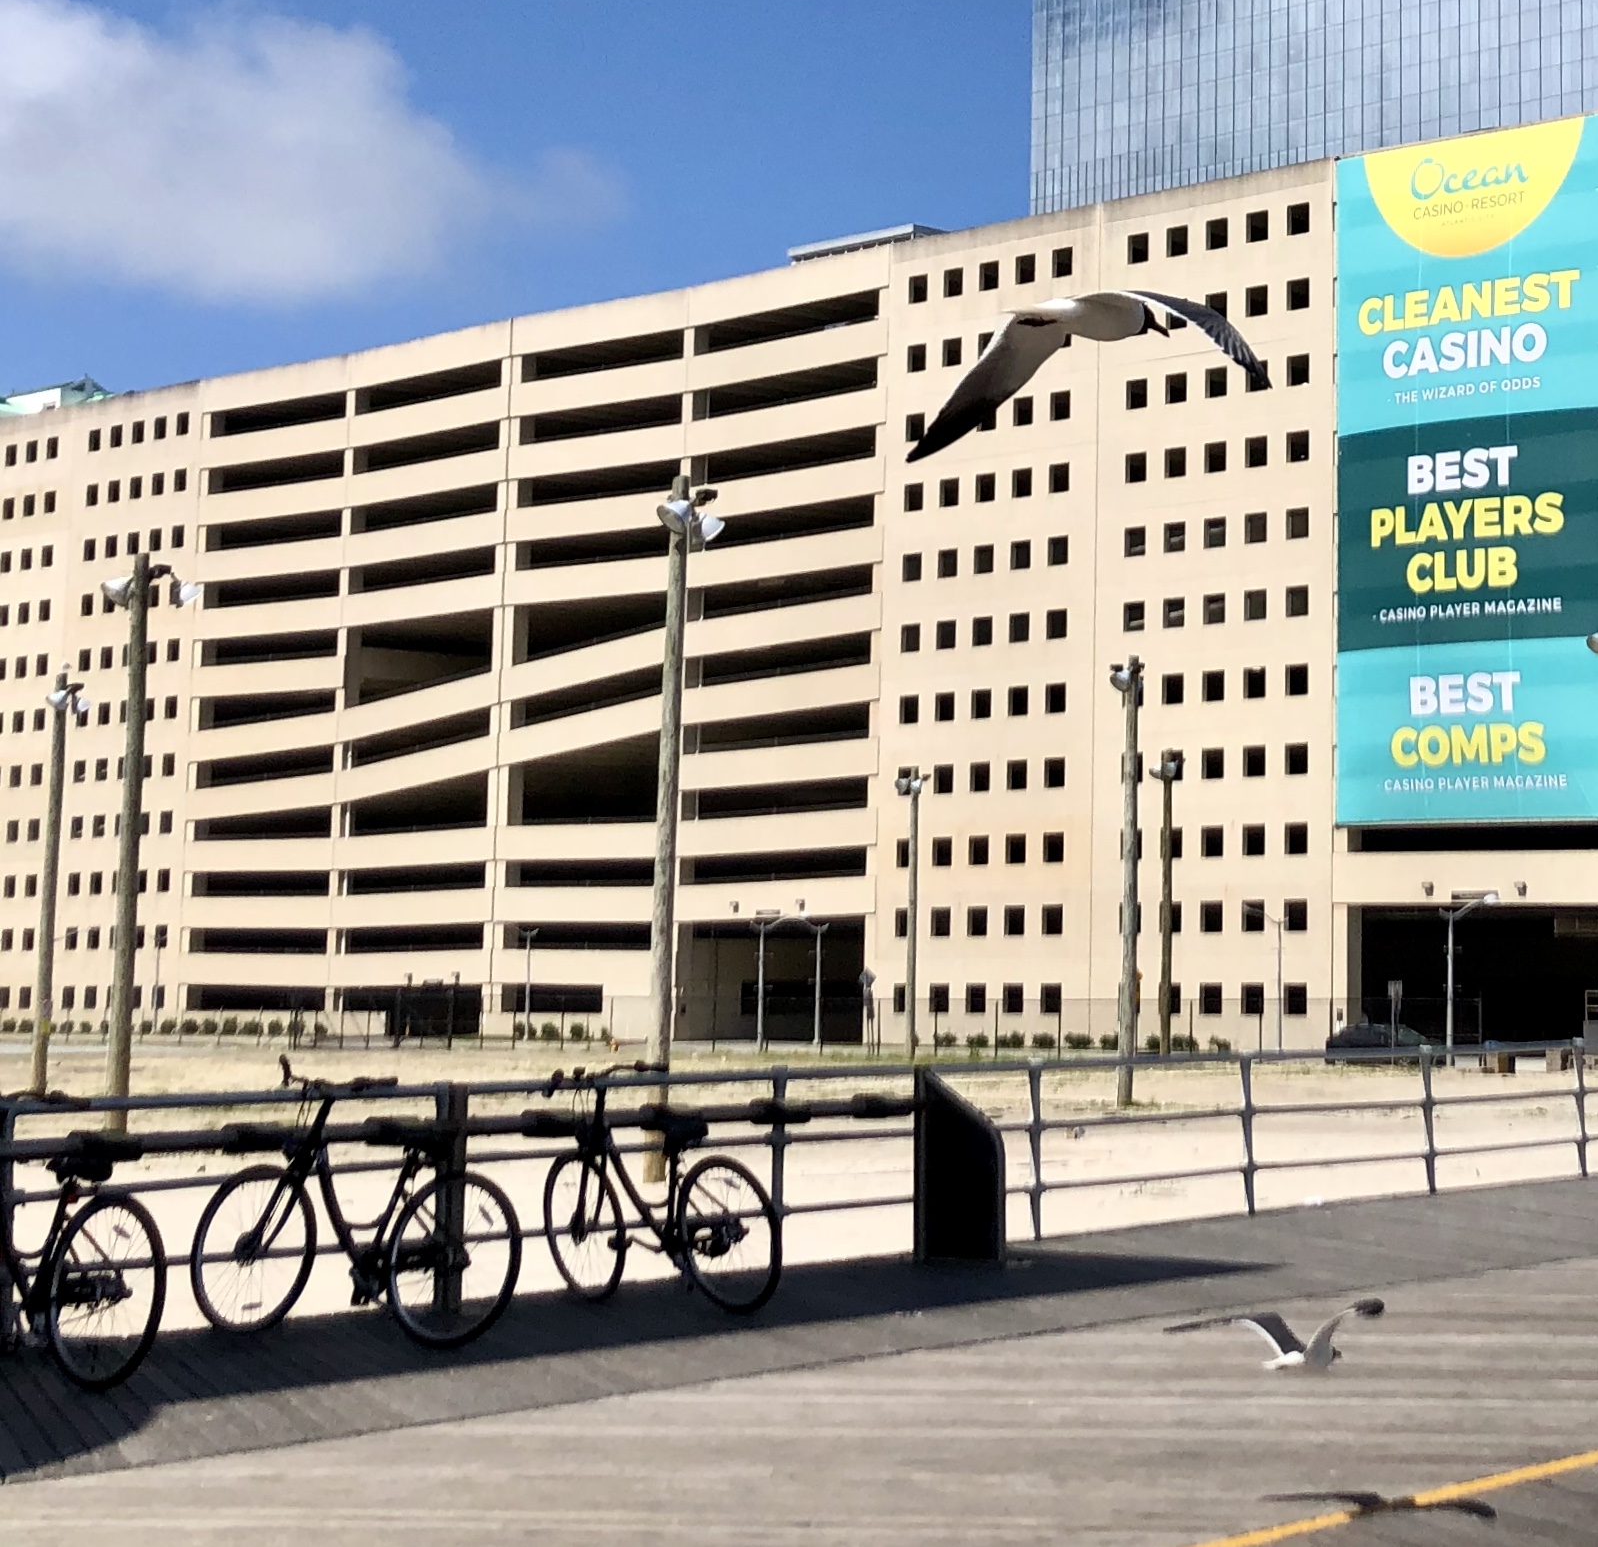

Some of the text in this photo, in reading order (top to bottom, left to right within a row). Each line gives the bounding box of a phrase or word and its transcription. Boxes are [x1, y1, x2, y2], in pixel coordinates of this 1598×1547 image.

[1410, 158, 1529, 200] Ocean
[1413, 191, 1525, 220] CASINO RESORT
[1358, 269, 1580, 336] CLEANEST
[1382, 322, 1548, 380] CASINO
[1394, 376, 1541, 404] THE WIZARD OF ODDS
[1407, 445, 1518, 495] BEST
[1370, 491, 1565, 549] PLAYERS
[1406, 545, 1518, 594] CLUB
[1379, 597, 1562, 622] CASINO PLAYER MAGAZINE
[1409, 670, 1521, 716] BEST
[1390, 721, 1546, 767] COMPS
[1384, 773, 1568, 792] CASINO PLAYER MAGAZINE
